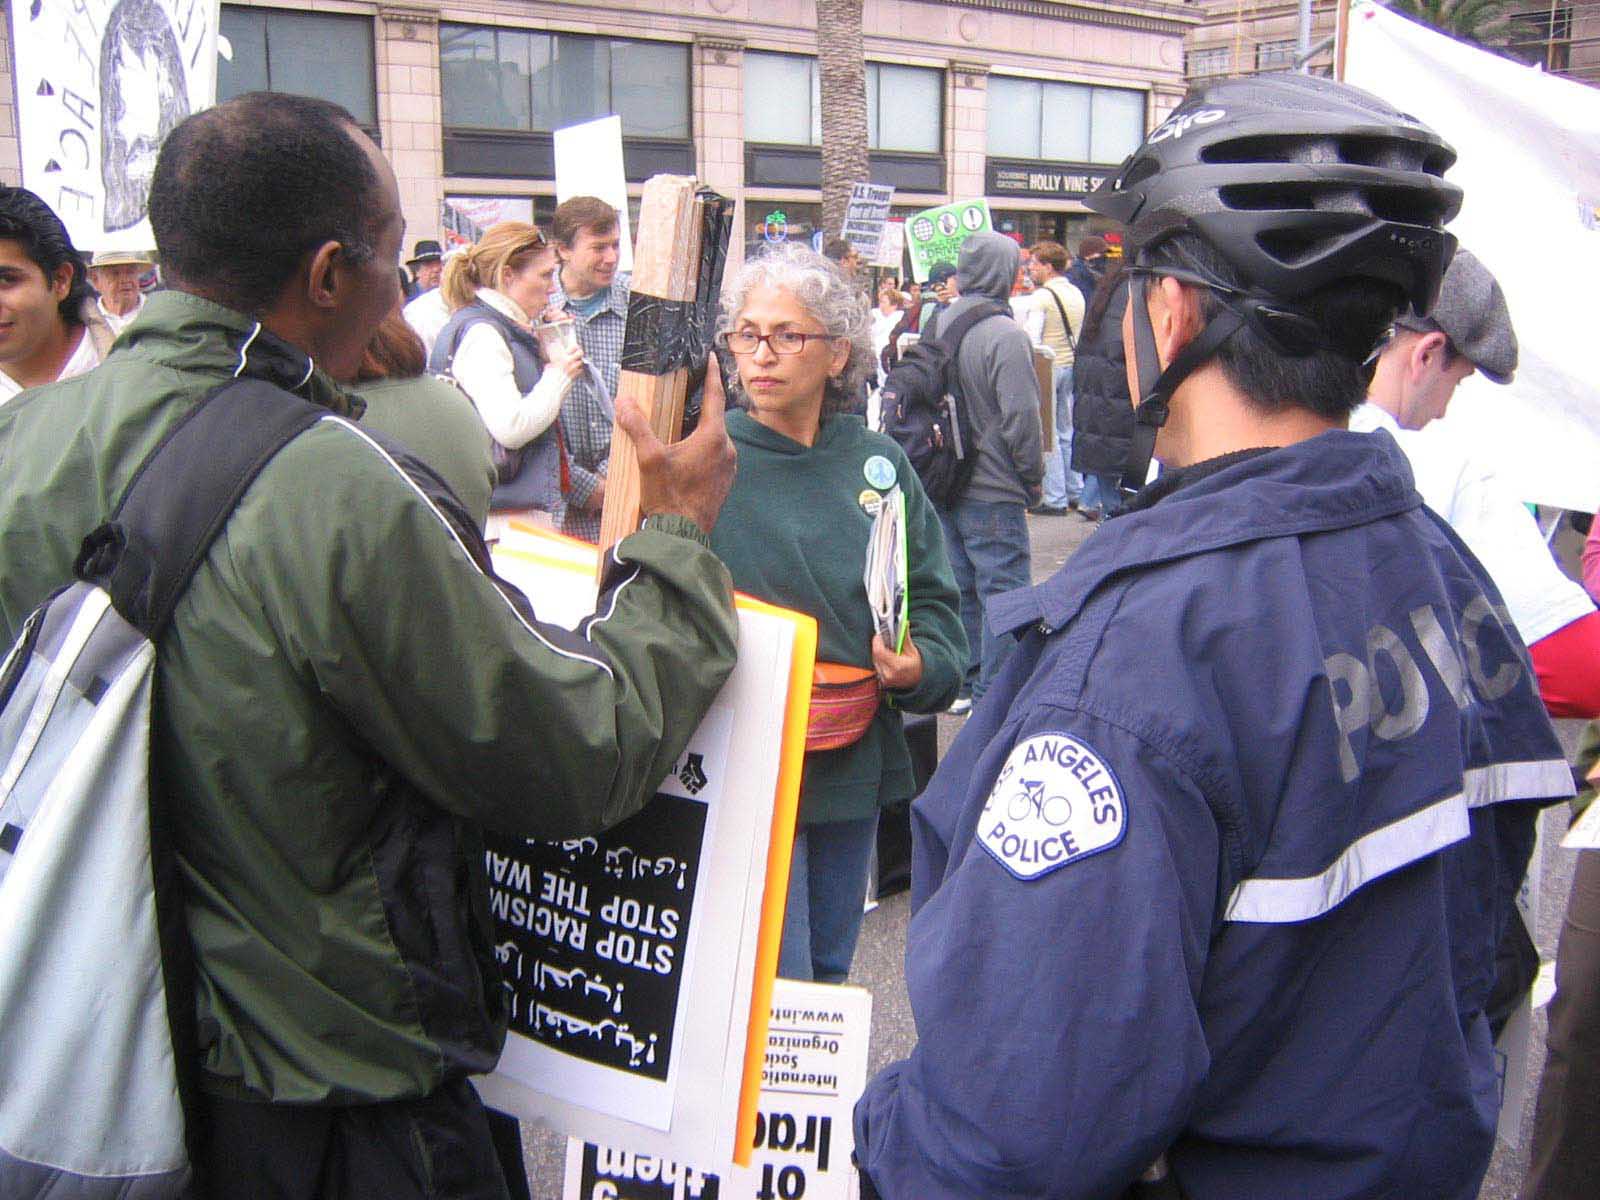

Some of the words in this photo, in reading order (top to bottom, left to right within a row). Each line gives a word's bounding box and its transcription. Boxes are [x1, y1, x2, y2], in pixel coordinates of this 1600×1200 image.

[1029, 173, 1061, 191] HOLLY
[1063, 175, 1089, 192] VINE
[1024, 740, 1118, 825] ANGELES
[987, 821, 1080, 863] POLICE
[540, 871, 591, 917] THE
[600, 896, 680, 939] STOP
[596, 931, 674, 975] STOP
